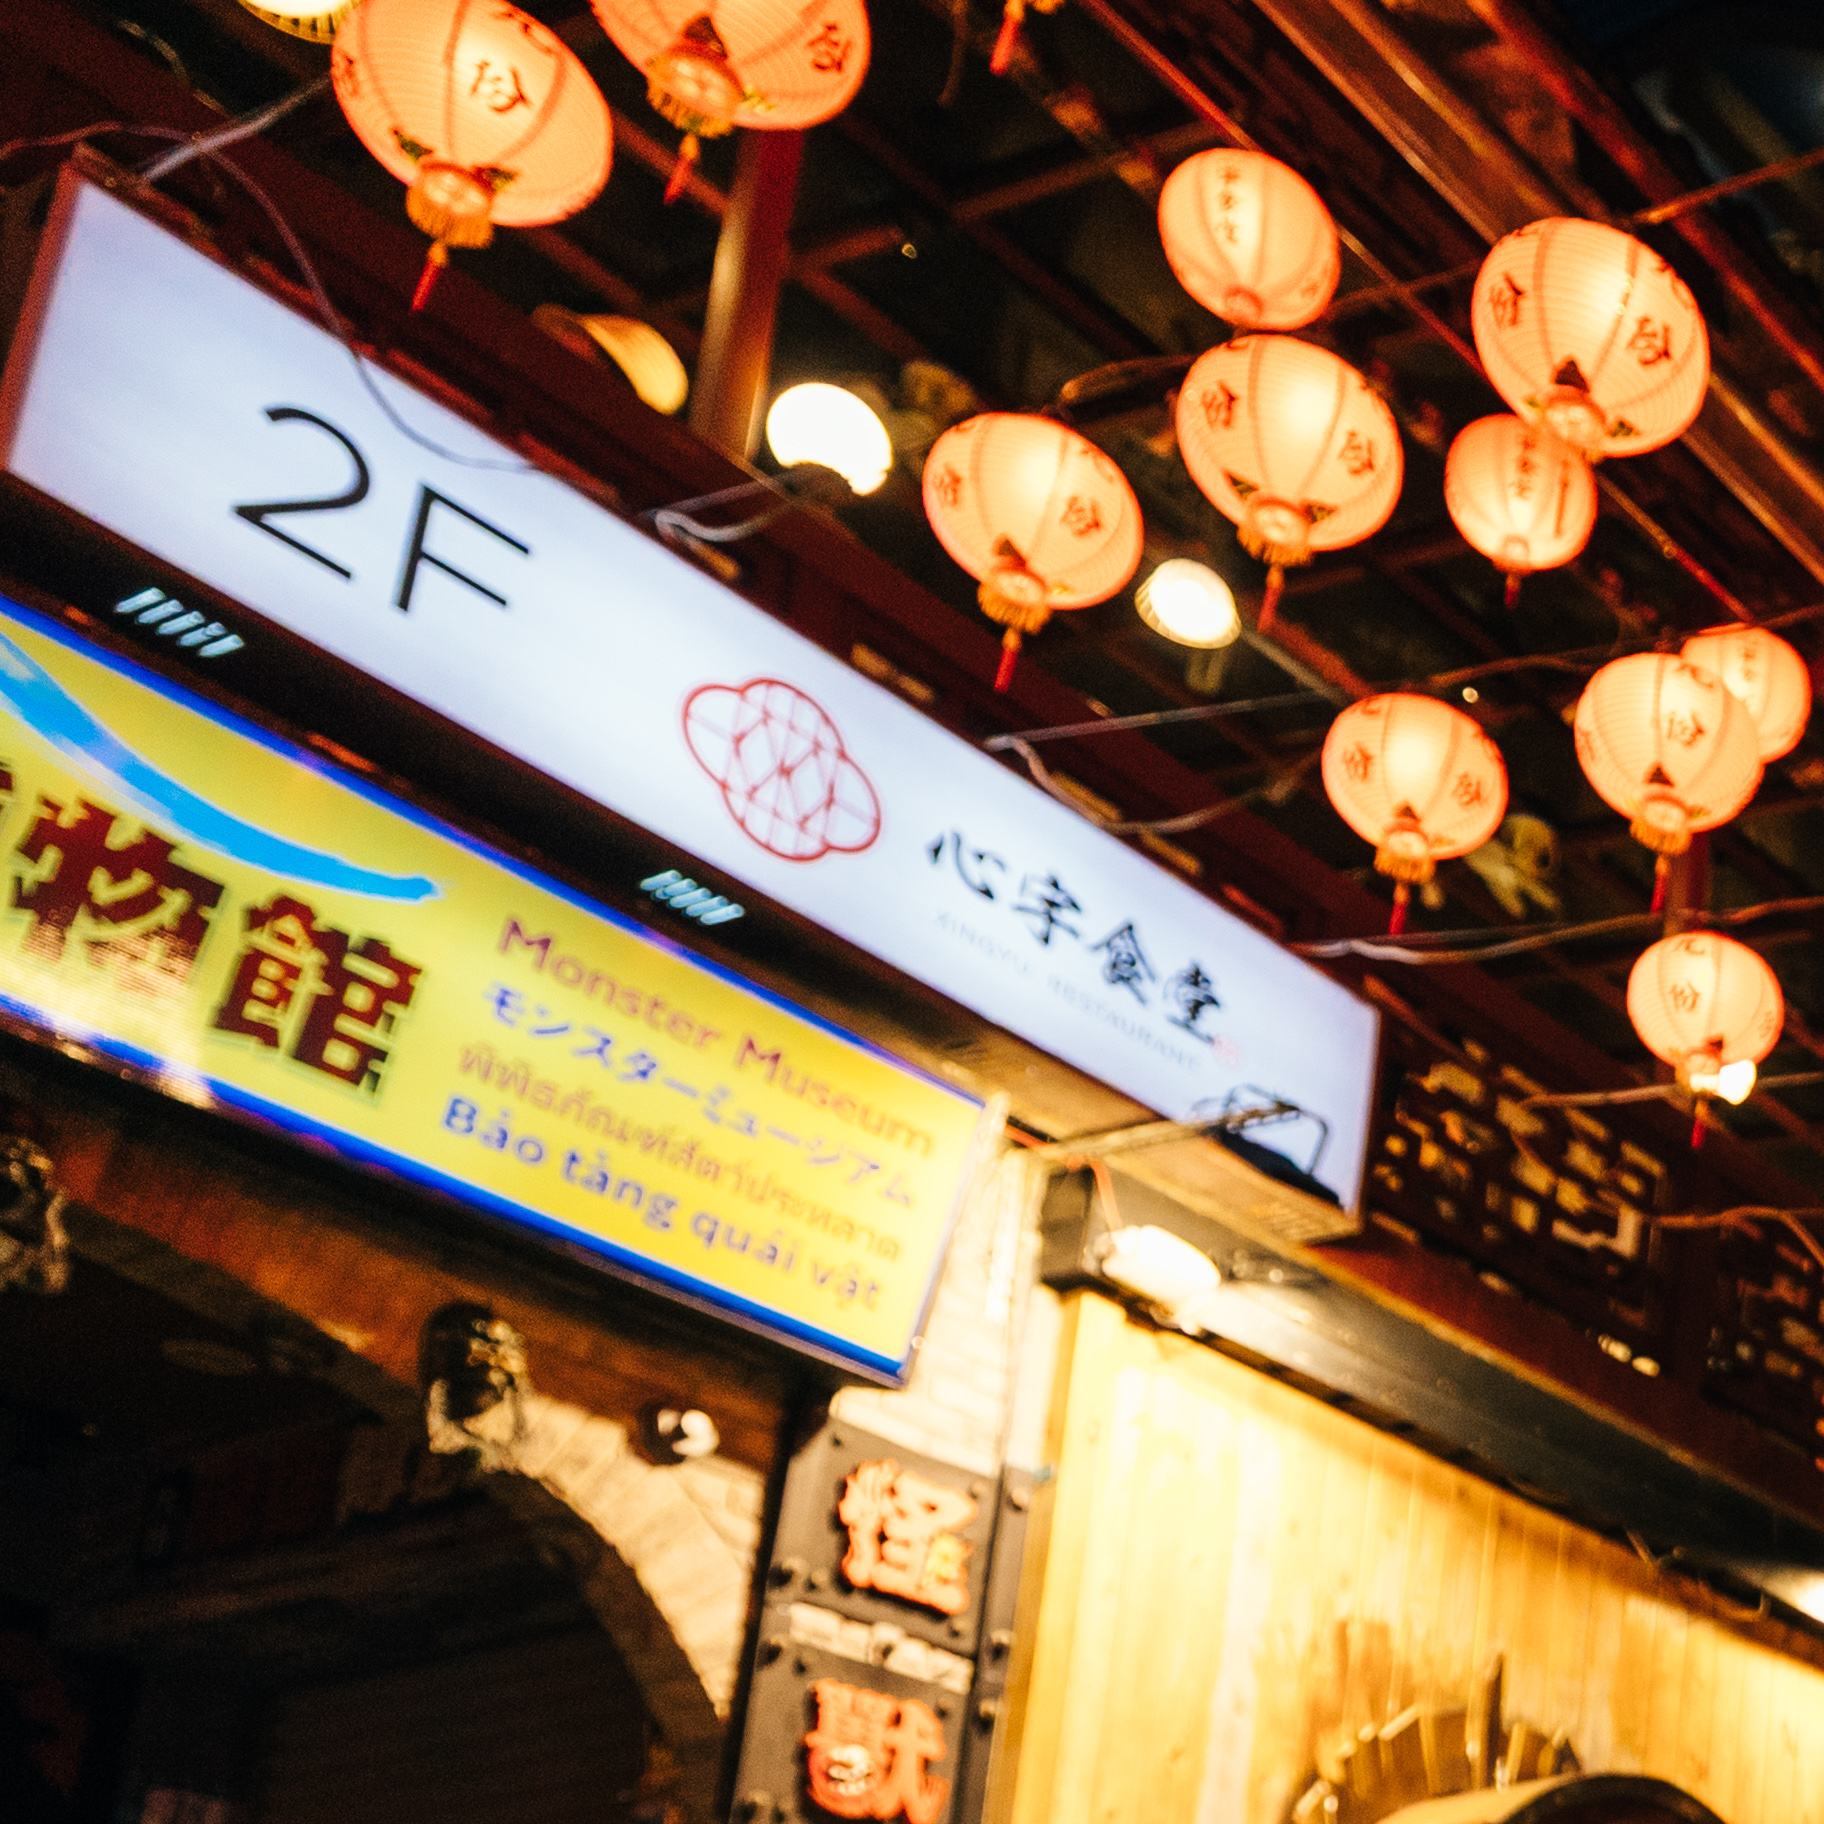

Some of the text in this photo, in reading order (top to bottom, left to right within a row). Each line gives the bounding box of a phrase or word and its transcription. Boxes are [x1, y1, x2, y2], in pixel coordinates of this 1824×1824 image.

[232, 406, 534, 616] 2F
[0, 764, 423, 1096] 物館
[500, 918, 934, 1158] Monster Museum
[485, 980, 915, 1208] モンスターミュージアム
